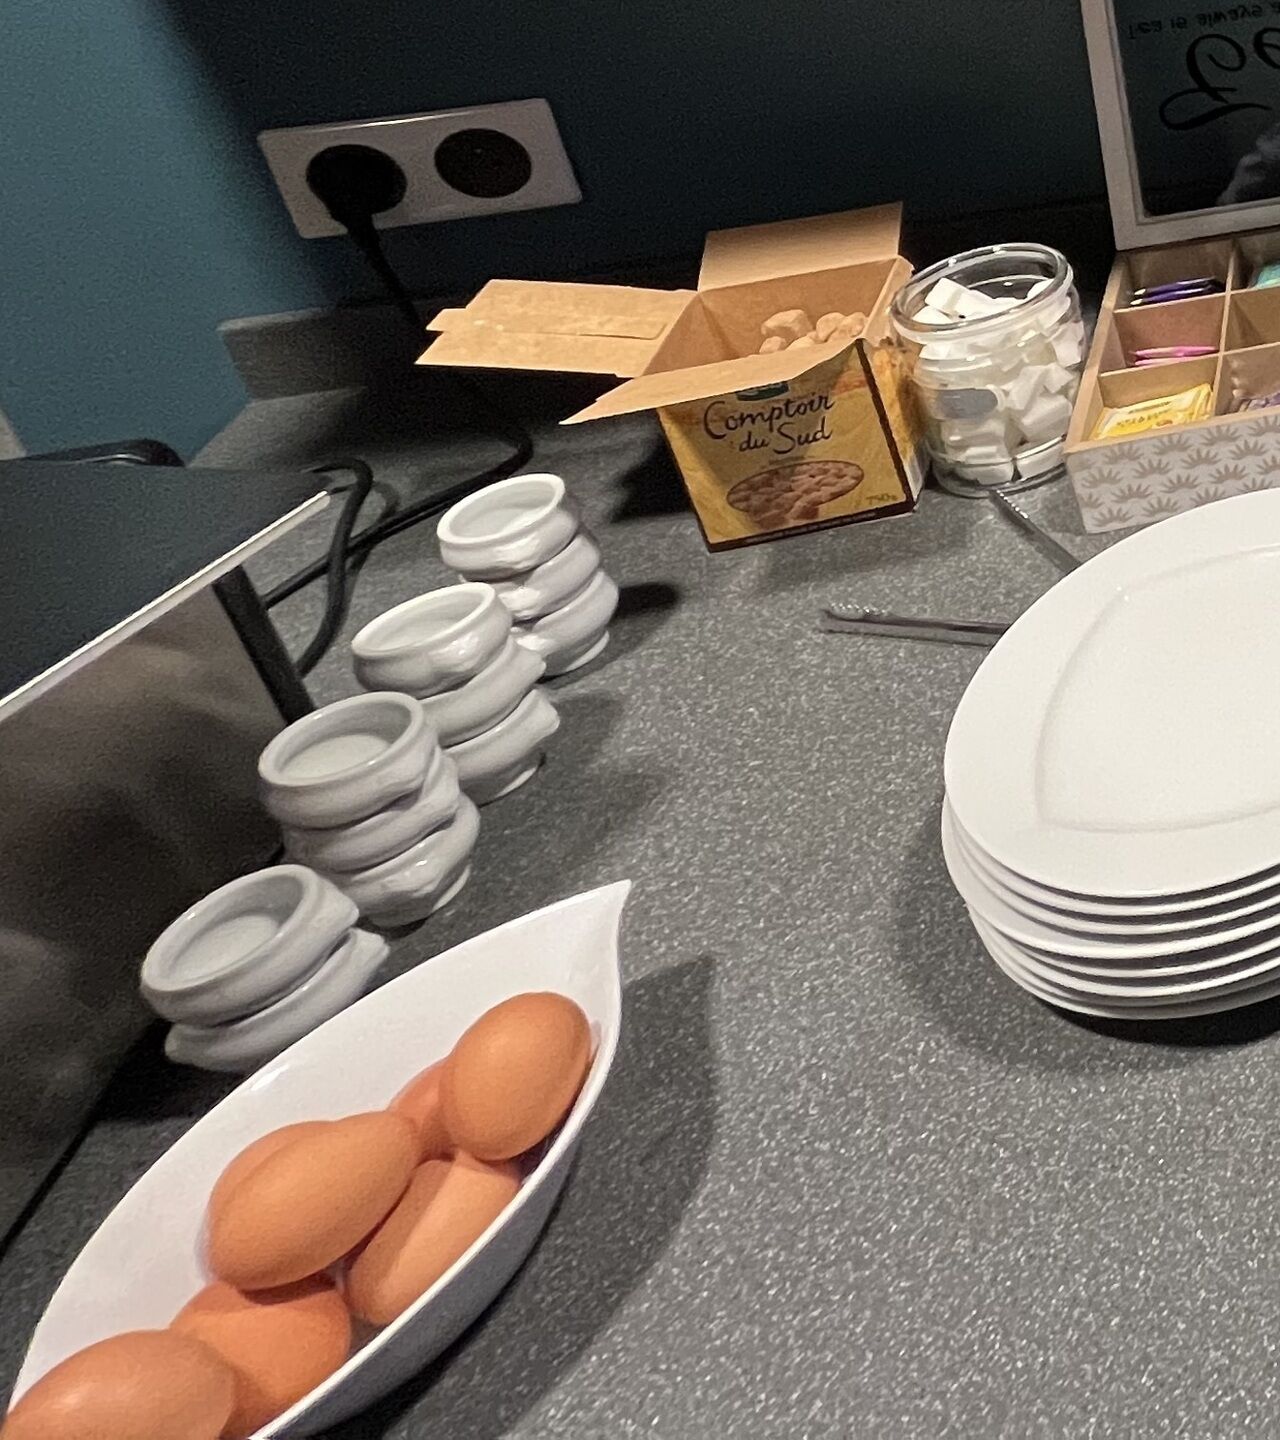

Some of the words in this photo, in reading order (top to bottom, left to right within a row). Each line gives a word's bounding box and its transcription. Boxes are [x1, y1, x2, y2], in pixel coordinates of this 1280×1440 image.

[703, 393, 835, 440] Comptoir
[738, 432, 770, 452] du
[773, 416, 833, 454] Sud
